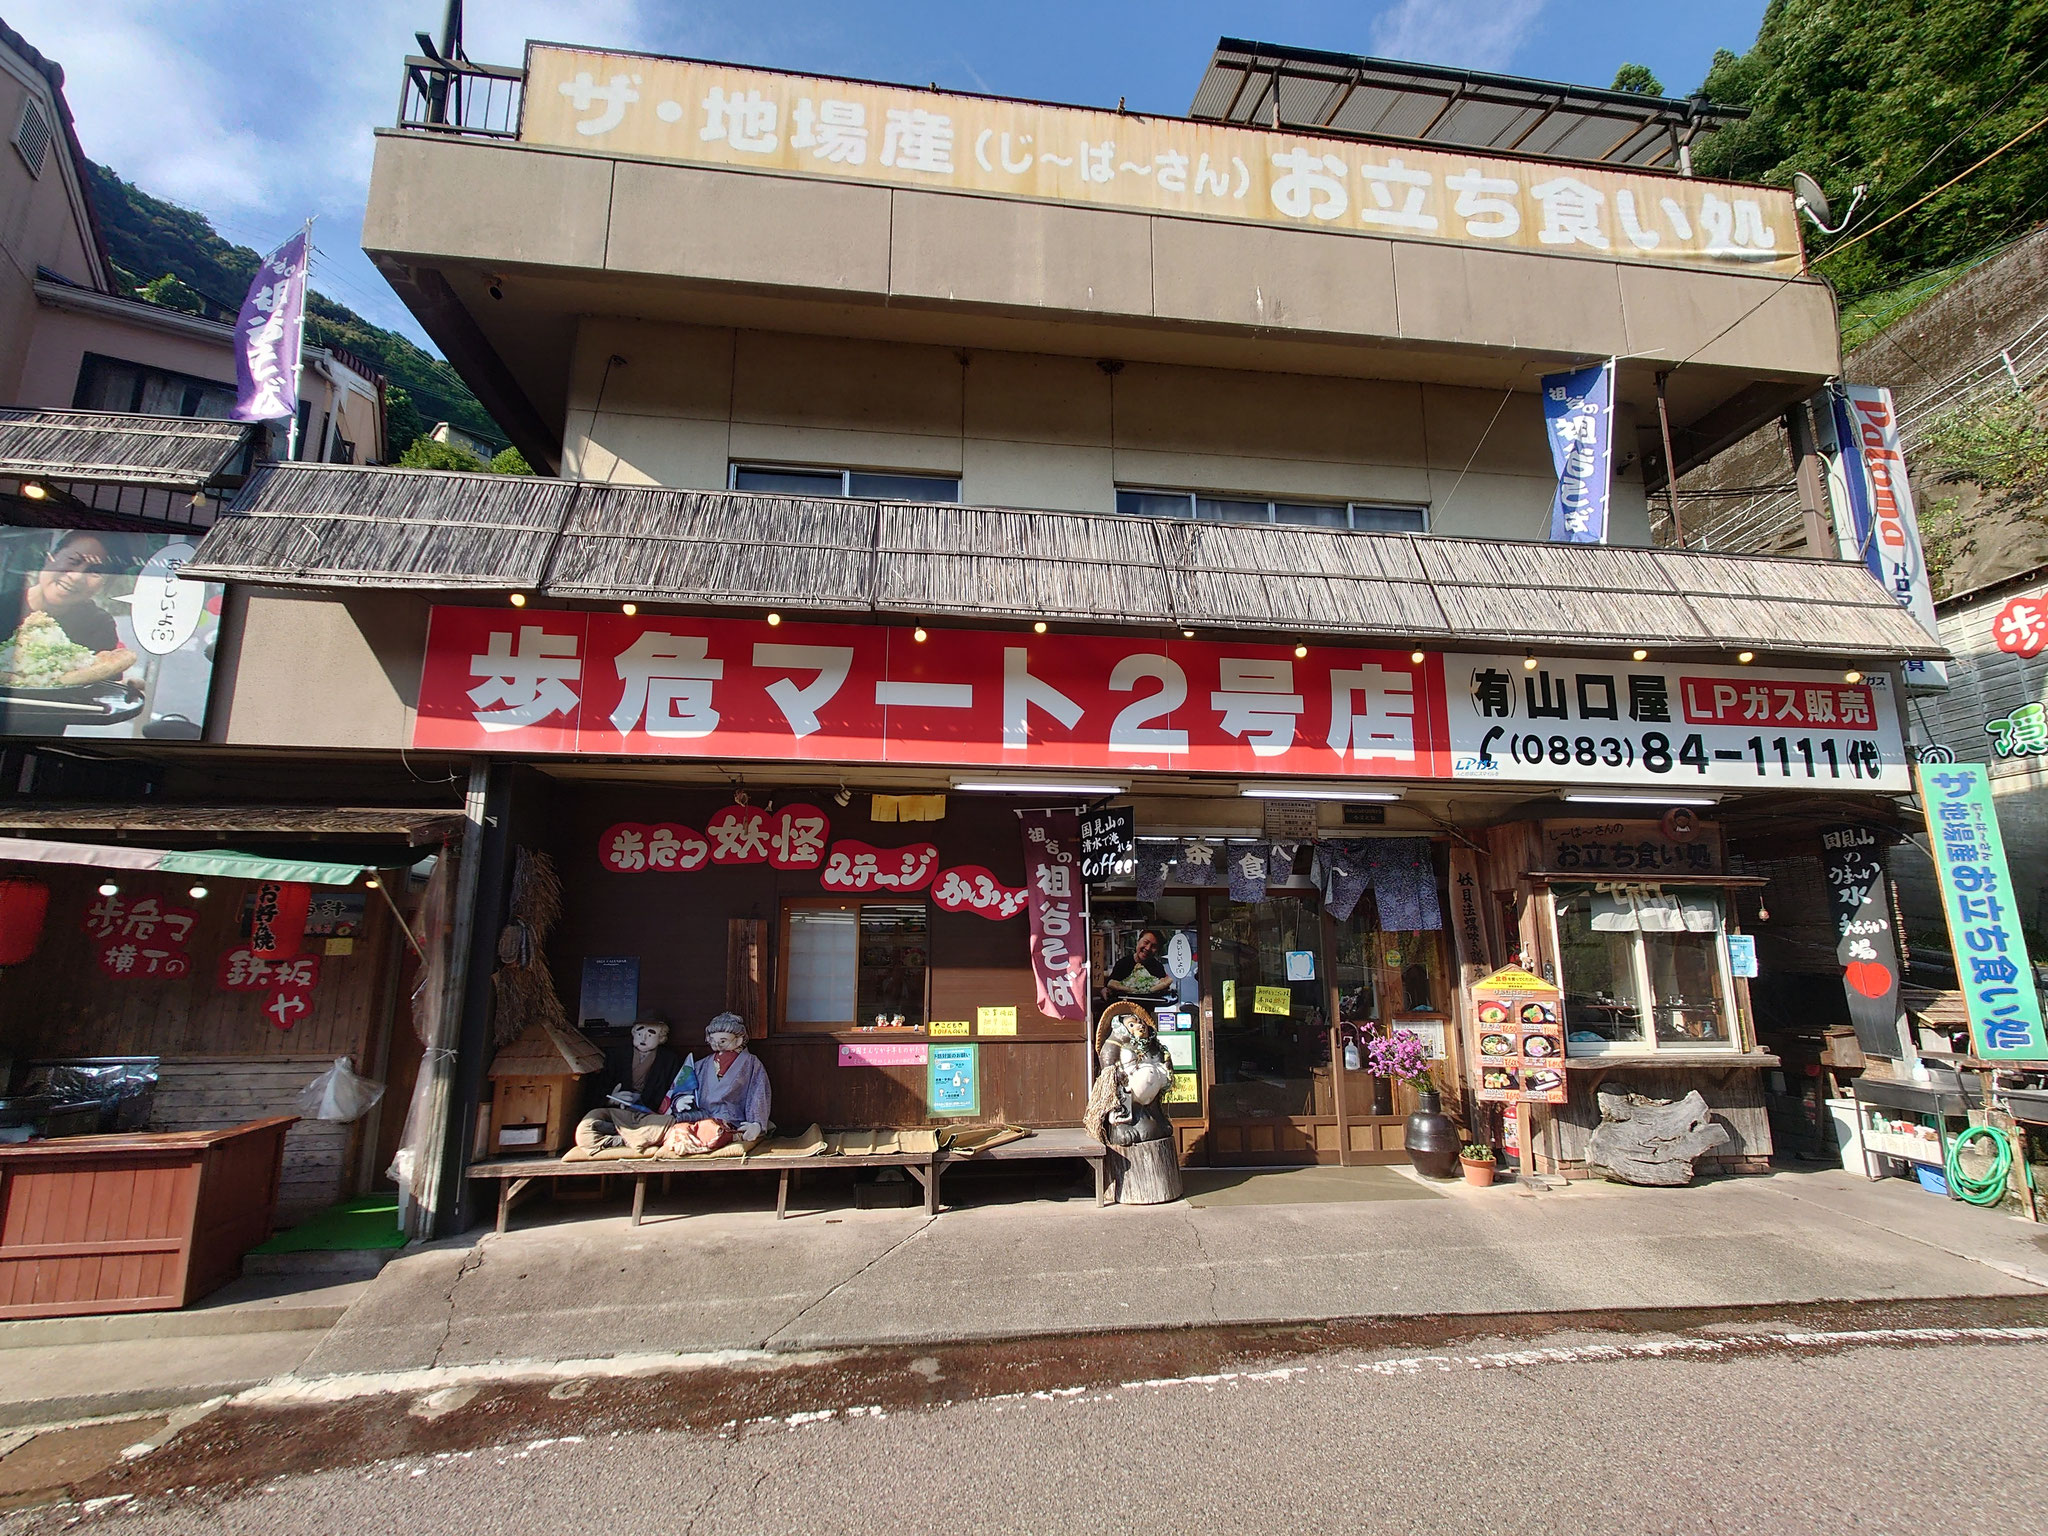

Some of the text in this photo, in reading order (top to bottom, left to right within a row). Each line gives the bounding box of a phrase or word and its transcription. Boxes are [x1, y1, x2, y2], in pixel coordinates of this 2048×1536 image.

[1854, 400, 1906, 547] Paloma
[466, 626, 1416, 762] 歩危マート2号店
[1689, 685, 1872, 725] LPガス販売
[708, 814, 825, 862] 妖怪
[1028, 827, 1073, 863] 祖谷の
[1081, 815, 1125, 839] 国見山の
[1843, 852, 1861, 863] の
[1838, 885, 1873, 907] 水
[252, 883, 282, 951] お好み焼
[1035, 863, 1078, 1007] 祖谷そば
[103, 943, 185, 974] 横丁の
[268, 993, 306, 1024] や
